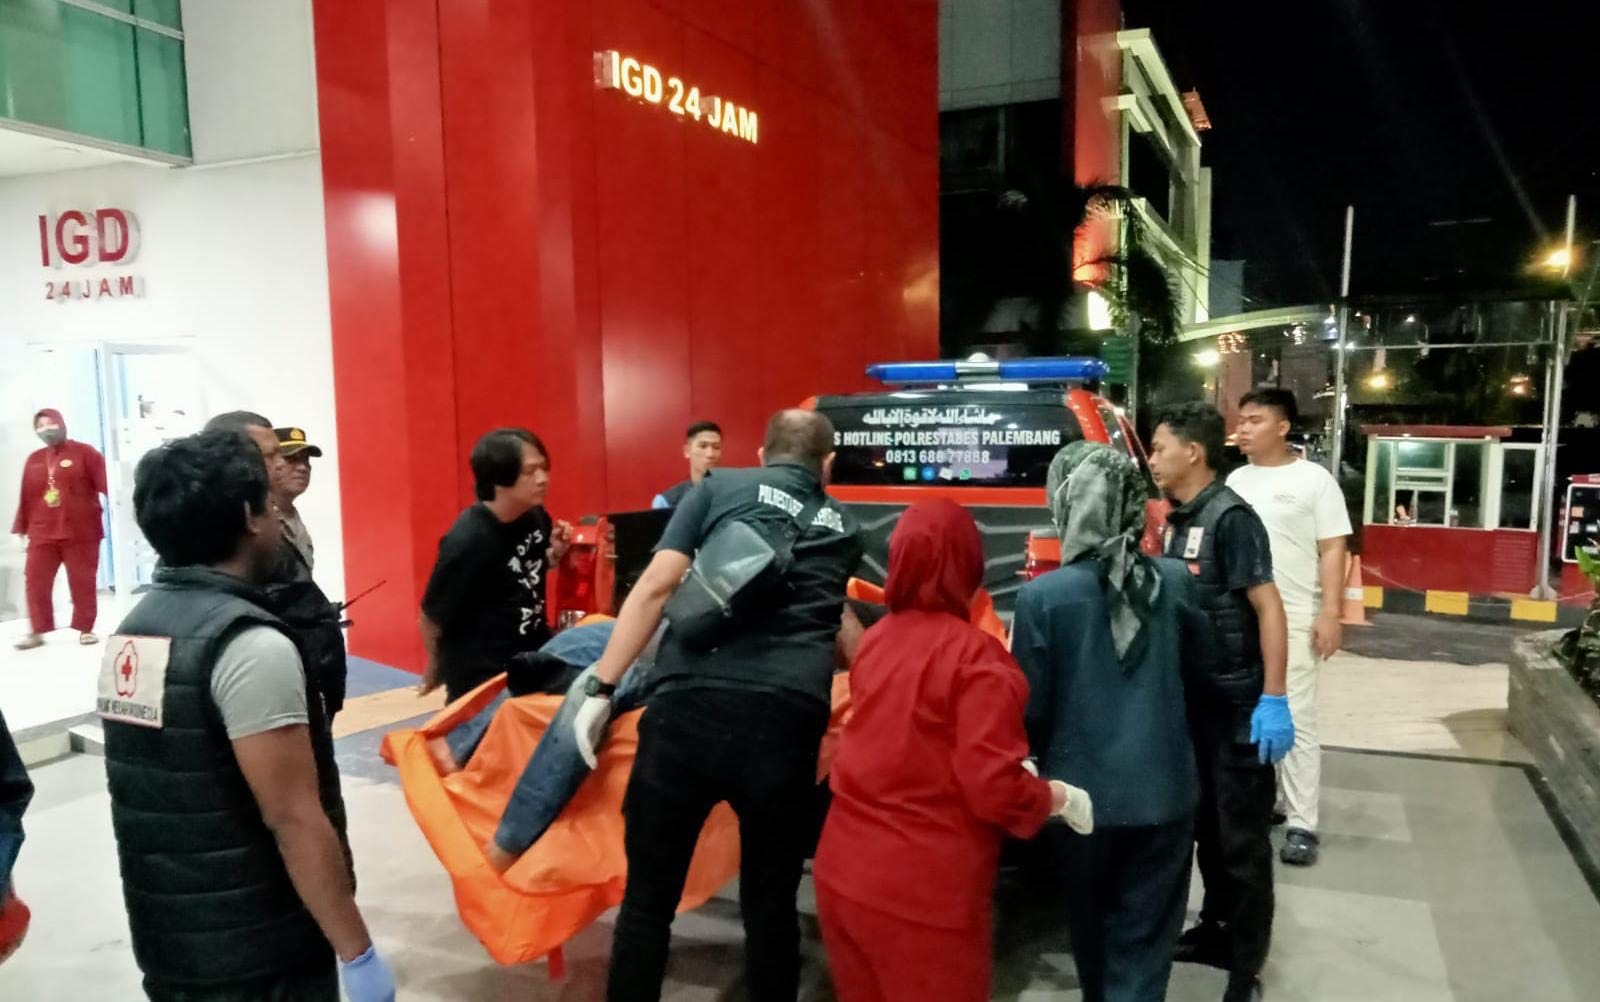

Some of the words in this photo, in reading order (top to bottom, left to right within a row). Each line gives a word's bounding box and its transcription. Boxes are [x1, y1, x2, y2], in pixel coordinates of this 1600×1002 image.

[612, 50, 663, 104] IGD
[668, 77, 701, 121] 24
[707, 97, 758, 144] JAM
[38, 208, 129, 267] IGD
[46, 281, 72, 300] 24
[82, 276, 134, 299] JAM
[982, 430, 1061, 446] PALEMBANG
[886, 449, 916, 464] 0813
